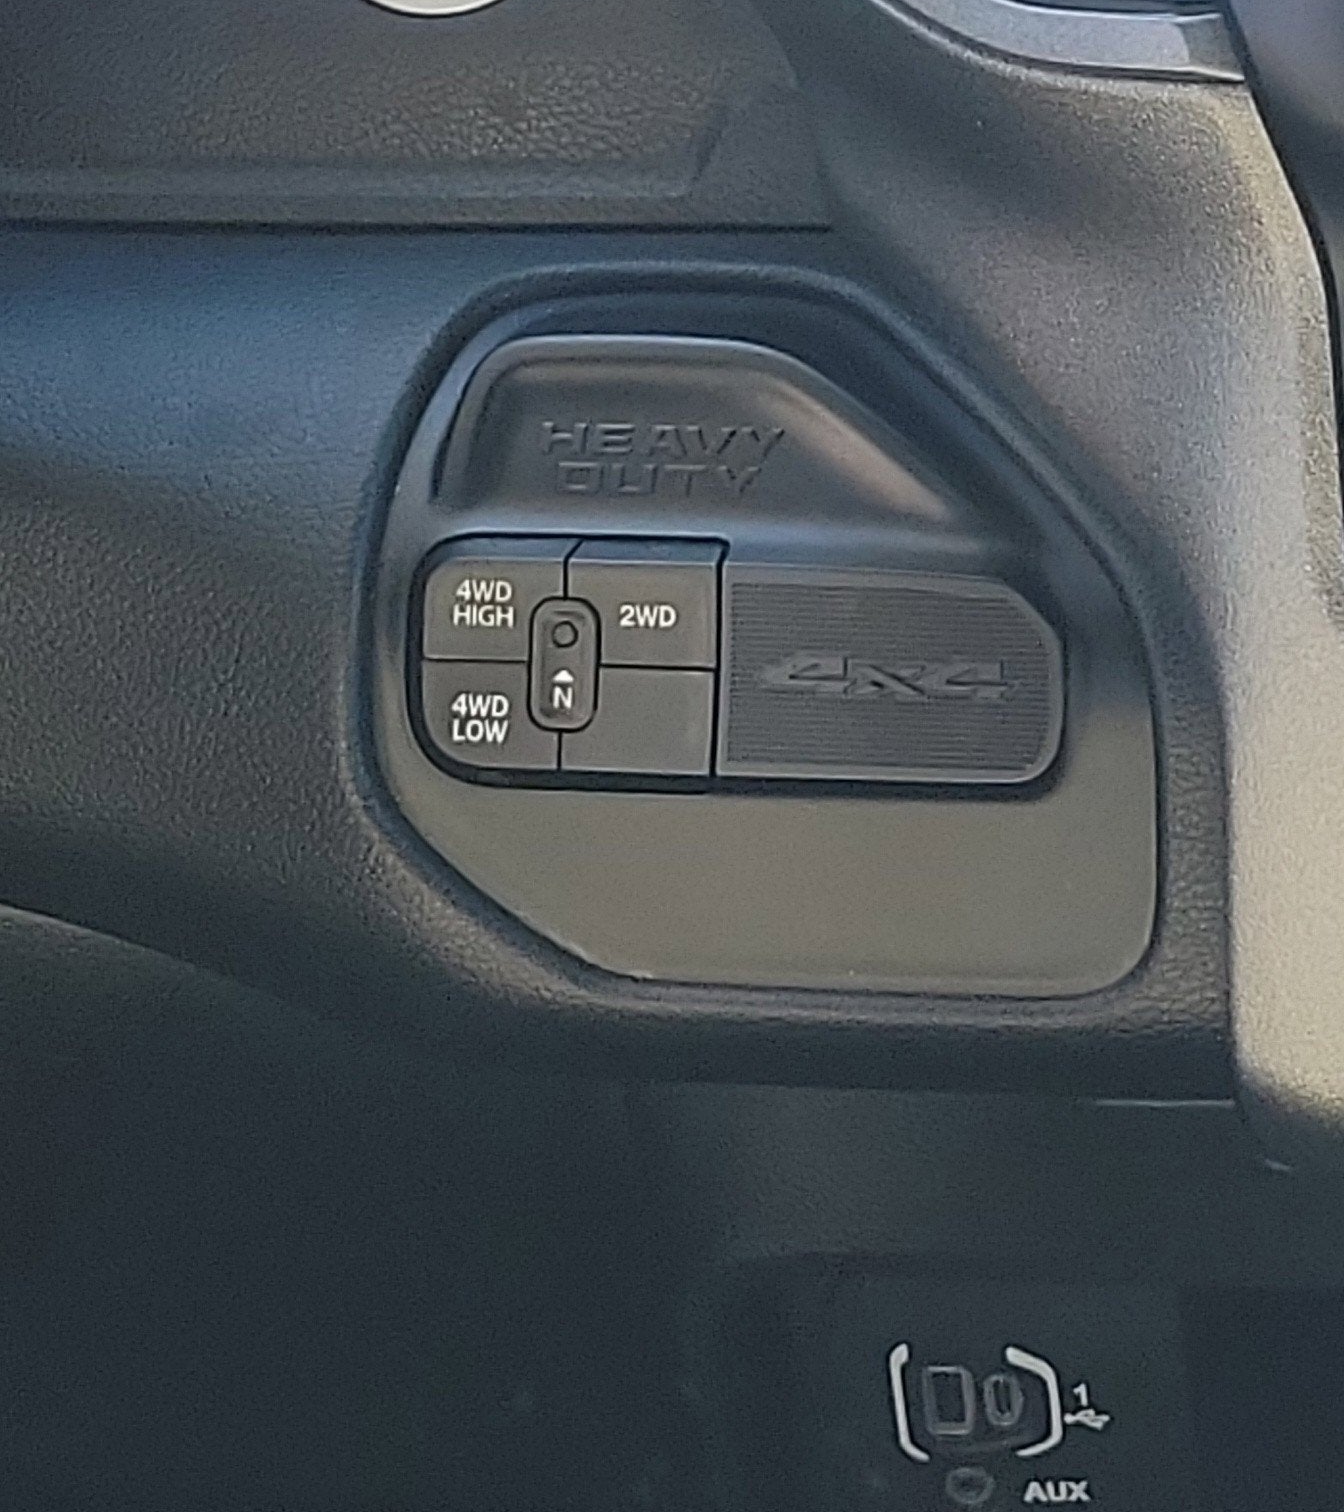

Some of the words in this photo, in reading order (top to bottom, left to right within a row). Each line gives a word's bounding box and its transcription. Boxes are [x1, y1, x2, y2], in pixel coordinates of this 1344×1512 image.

[542, 420, 786, 458] HEAVY
[557, 461, 762, 494] DUTY
[455, 579, 513, 603] 4WD
[453, 604, 515, 628] HIGH
[619, 604, 677, 628] 2WD
[451, 693, 510, 717] 4WD
[553, 686, 573, 709] N
[452, 720, 509, 744] LOW
[1072, 1382, 1089, 1407] 1
[1023, 1479, 1092, 1504] AUX
